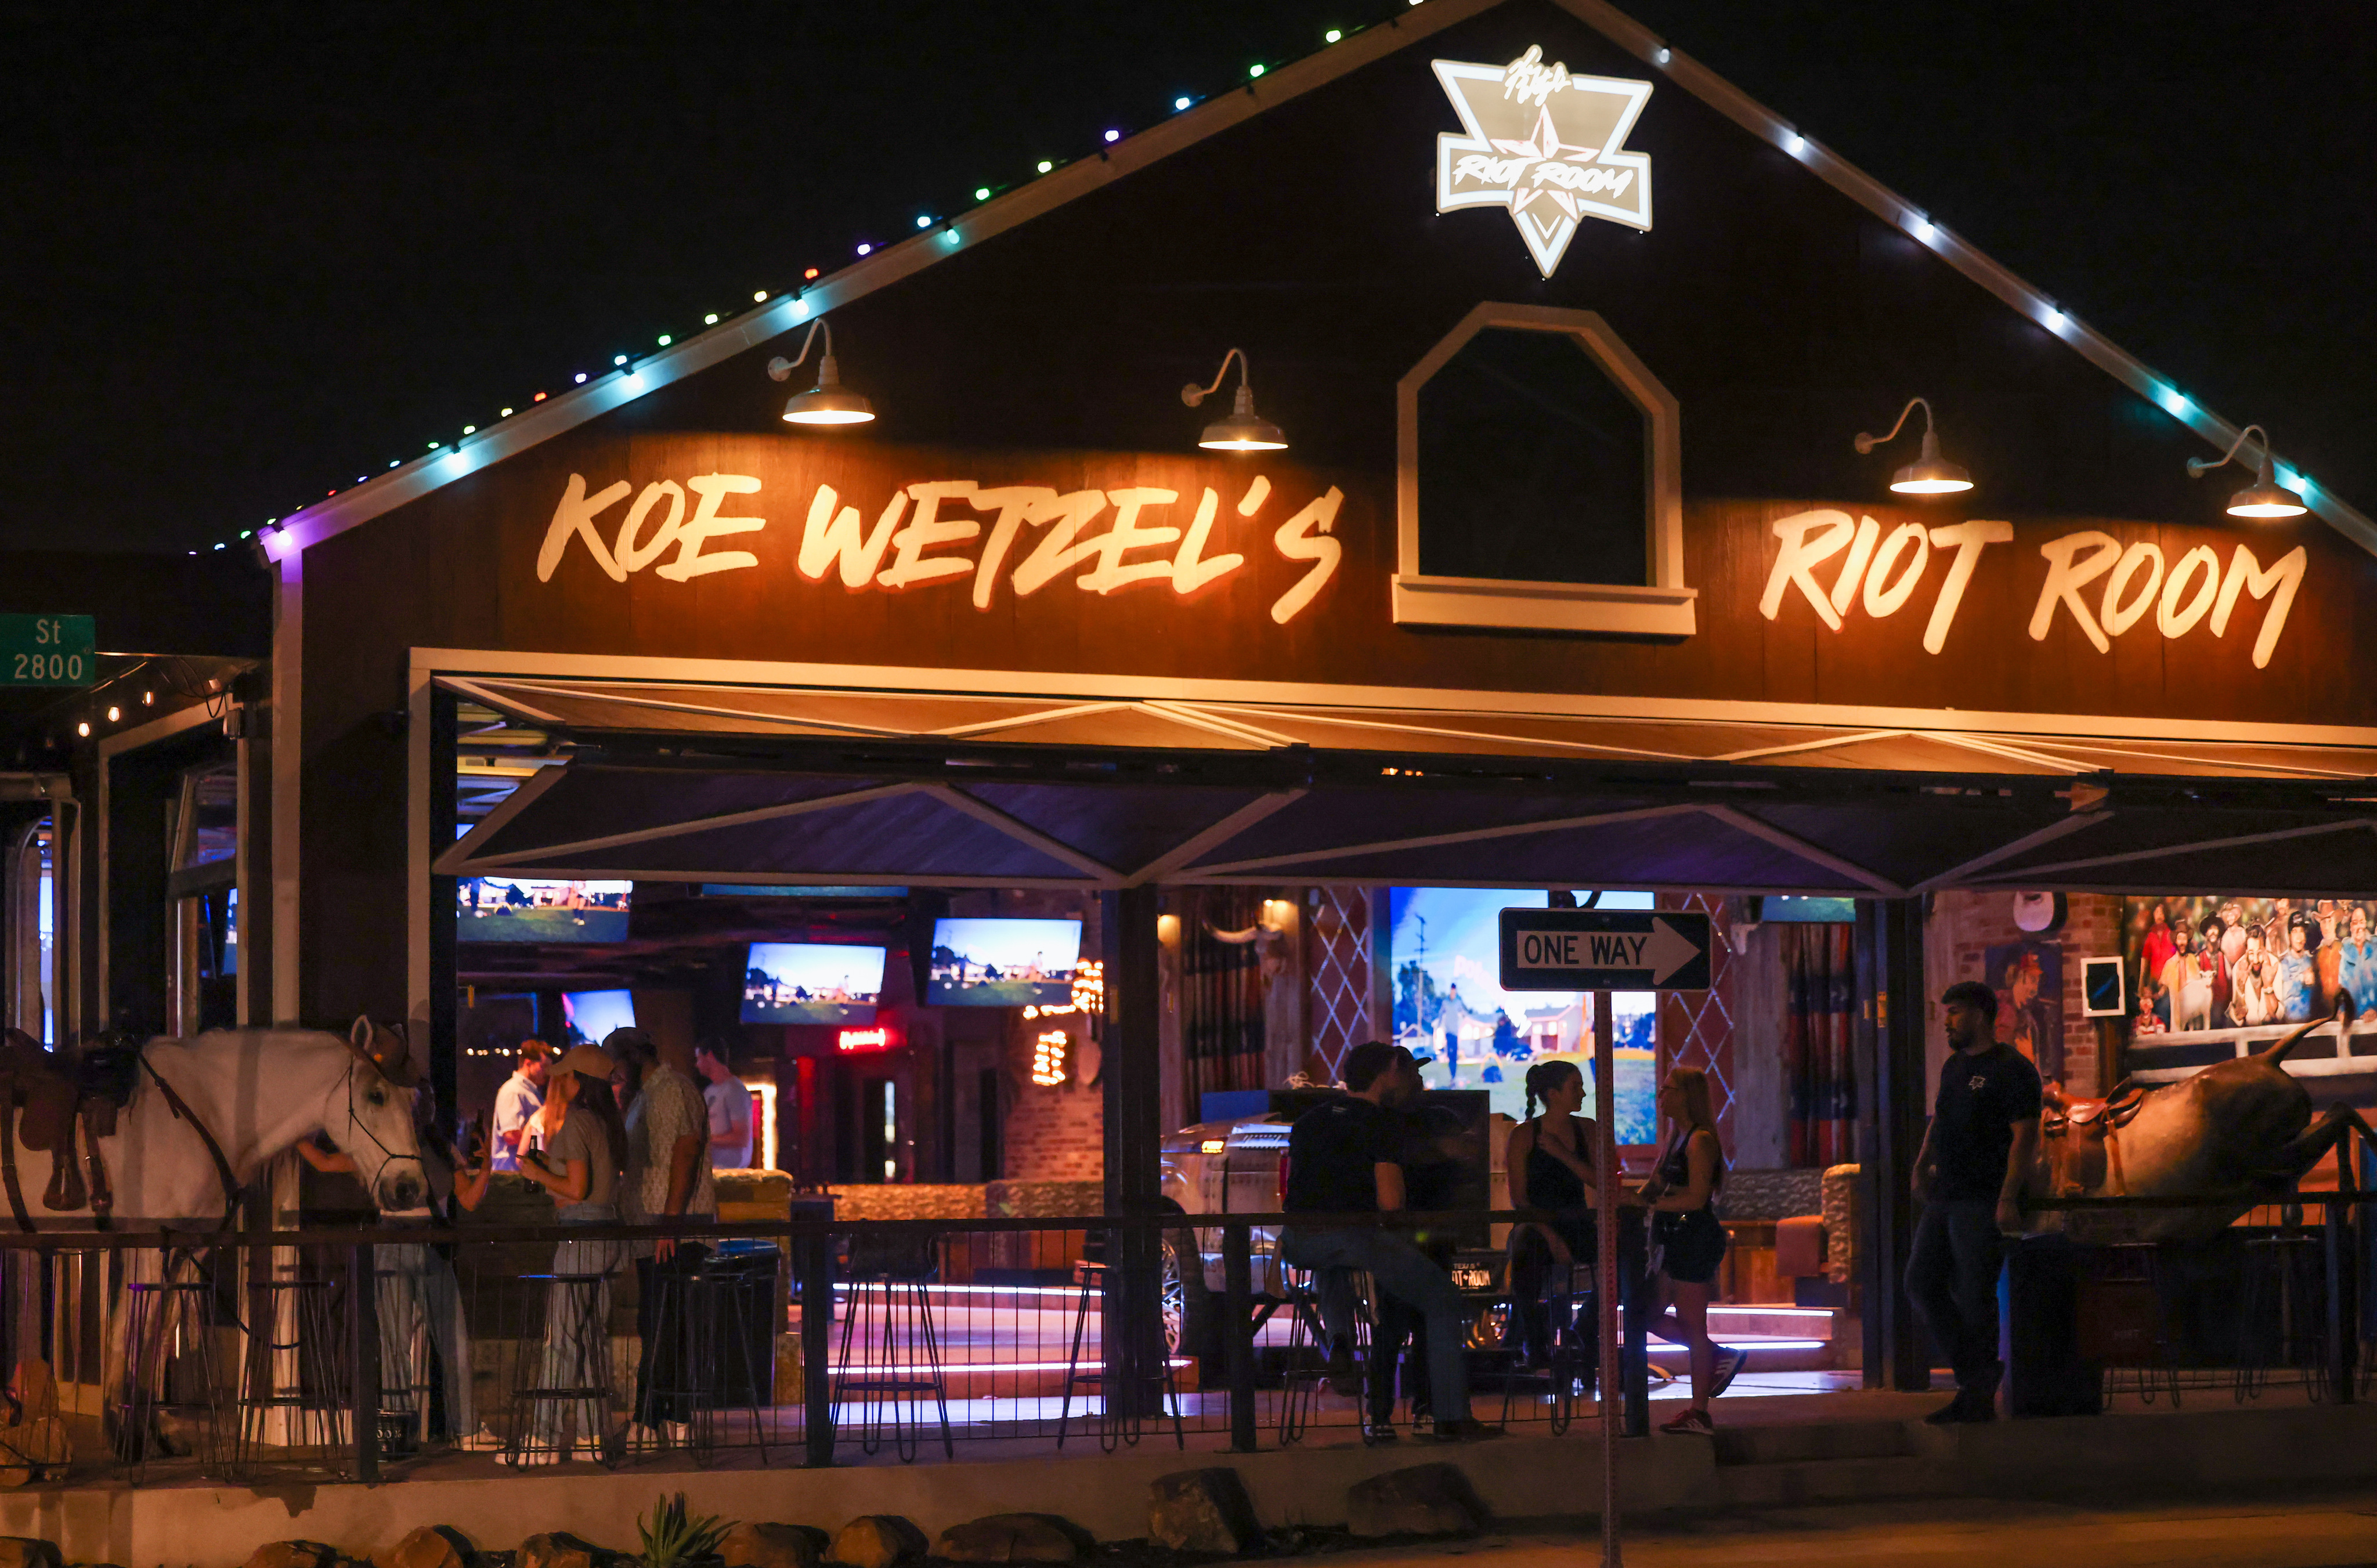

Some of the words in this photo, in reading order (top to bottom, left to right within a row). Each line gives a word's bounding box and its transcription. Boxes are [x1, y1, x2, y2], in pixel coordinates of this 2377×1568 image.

[1452, 154, 1547, 190] RIOT
[1531, 162, 1634, 199] ROOM
[537, 472, 767, 583] KOE
[798, 475, 1345, 624] WETZEL'S
[1759, 509, 2013, 655] RIOT
[2028, 530, 2307, 669] ROOM
[36, 619, 60, 644] St
[15, 653, 82, 680] 2800
[1524, 934, 1579, 964] ONE
[1590, 936, 1648, 966] WAY
